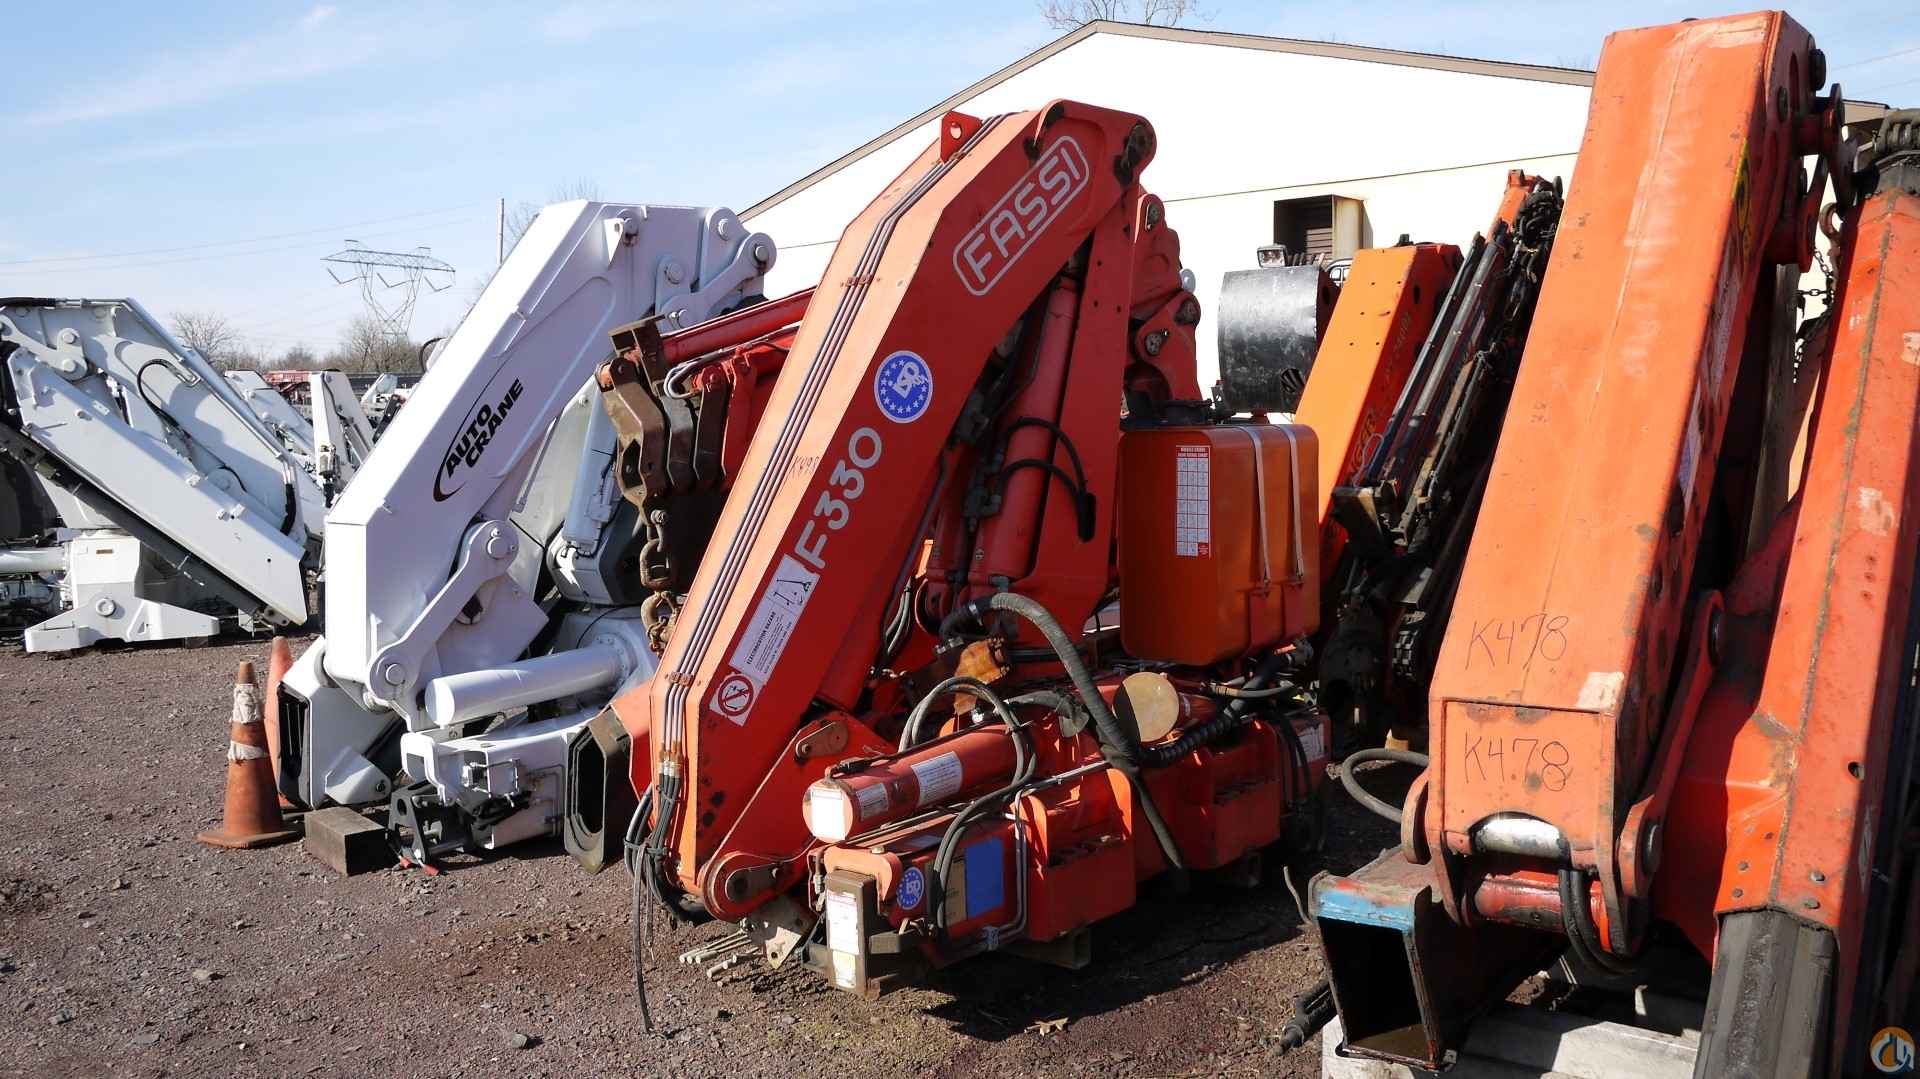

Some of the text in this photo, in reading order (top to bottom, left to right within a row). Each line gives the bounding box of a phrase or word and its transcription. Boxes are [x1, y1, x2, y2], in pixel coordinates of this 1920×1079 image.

[963, 147, 1081, 283] FASSI
[445, 404, 492, 478] AUTO
[465, 378, 524, 468] CRANE
[794, 427, 882, 569] F330
[1465, 613, 1569, 671] K478
[1464, 731, 1573, 792] K478
